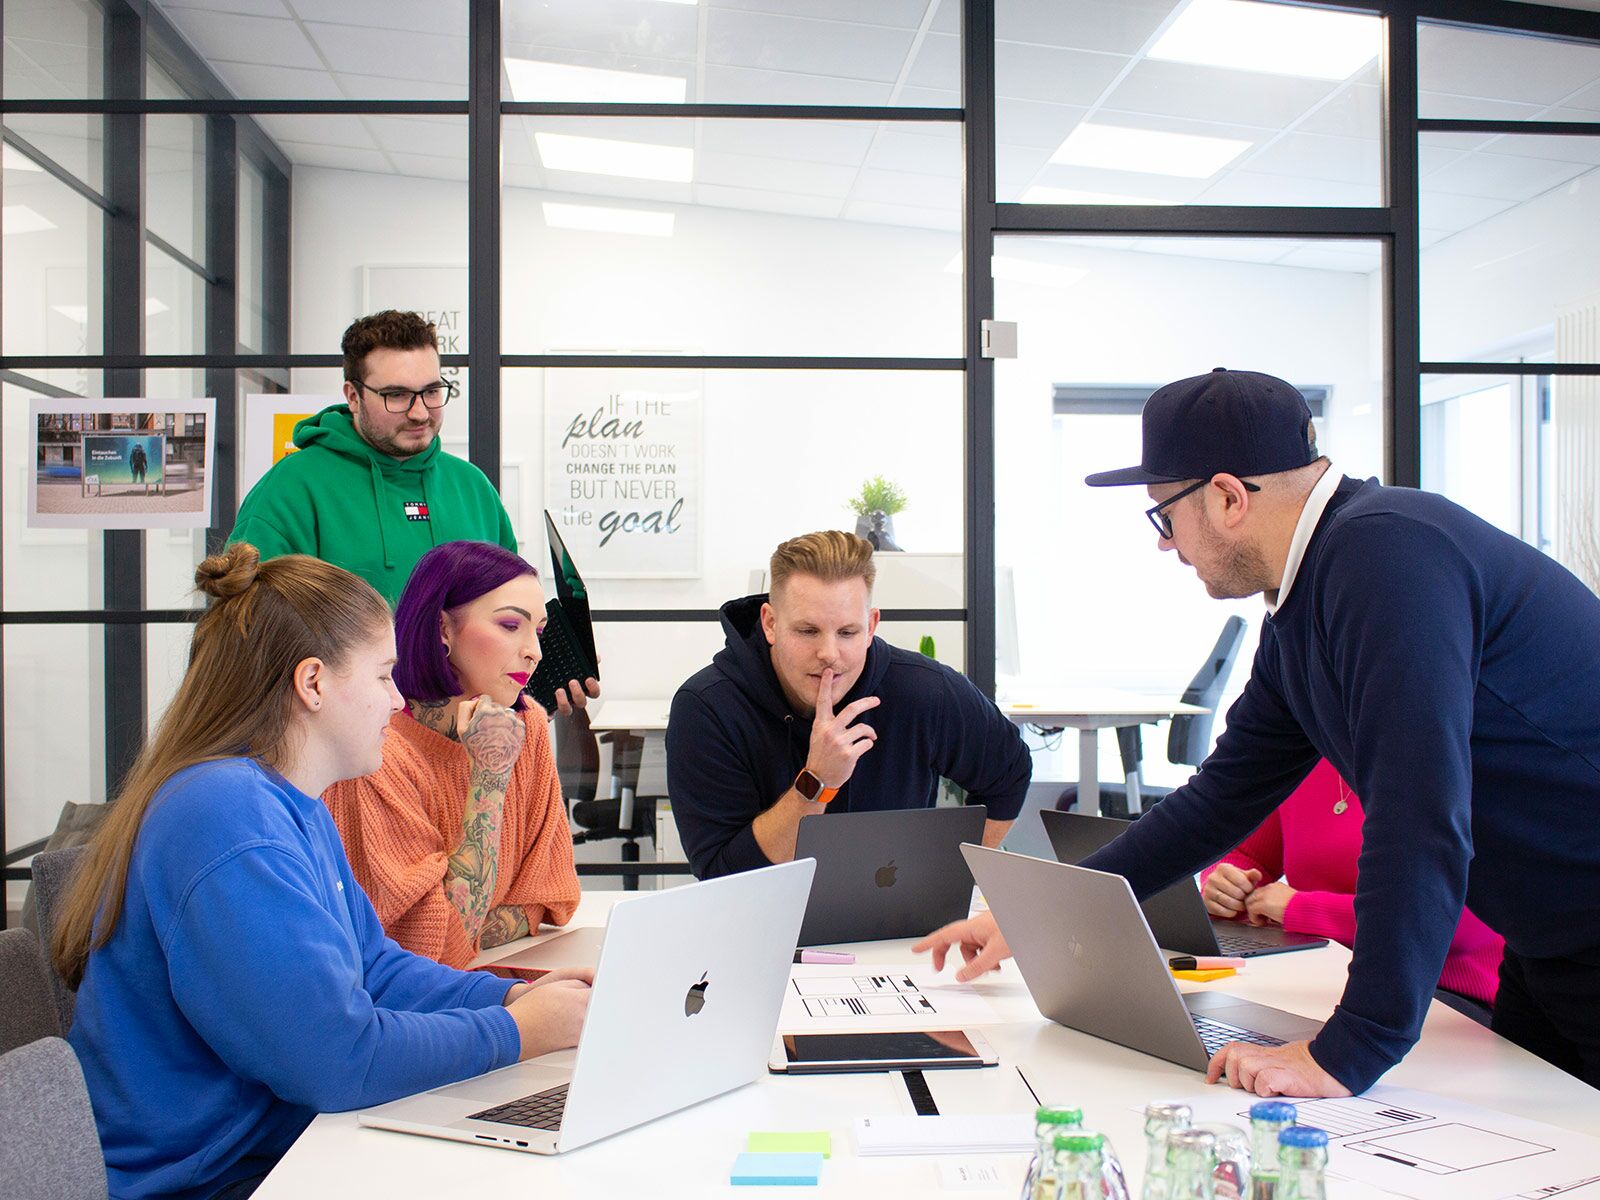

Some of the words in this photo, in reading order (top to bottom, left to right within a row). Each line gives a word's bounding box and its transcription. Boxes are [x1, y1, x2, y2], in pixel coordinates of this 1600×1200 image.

[609, 394, 624, 416] IF
[561, 406, 644, 449] plan
[634, 444, 676, 458] WORK
[566, 463, 616, 475] CHANGE
[620, 463, 641, 475] THE
[645, 463, 676, 475] PLAN
[571, 480, 607, 500] BUT
[614, 480, 677, 500] NEVER
[563, 505, 593, 526] the
[599, 497, 684, 548] goal
